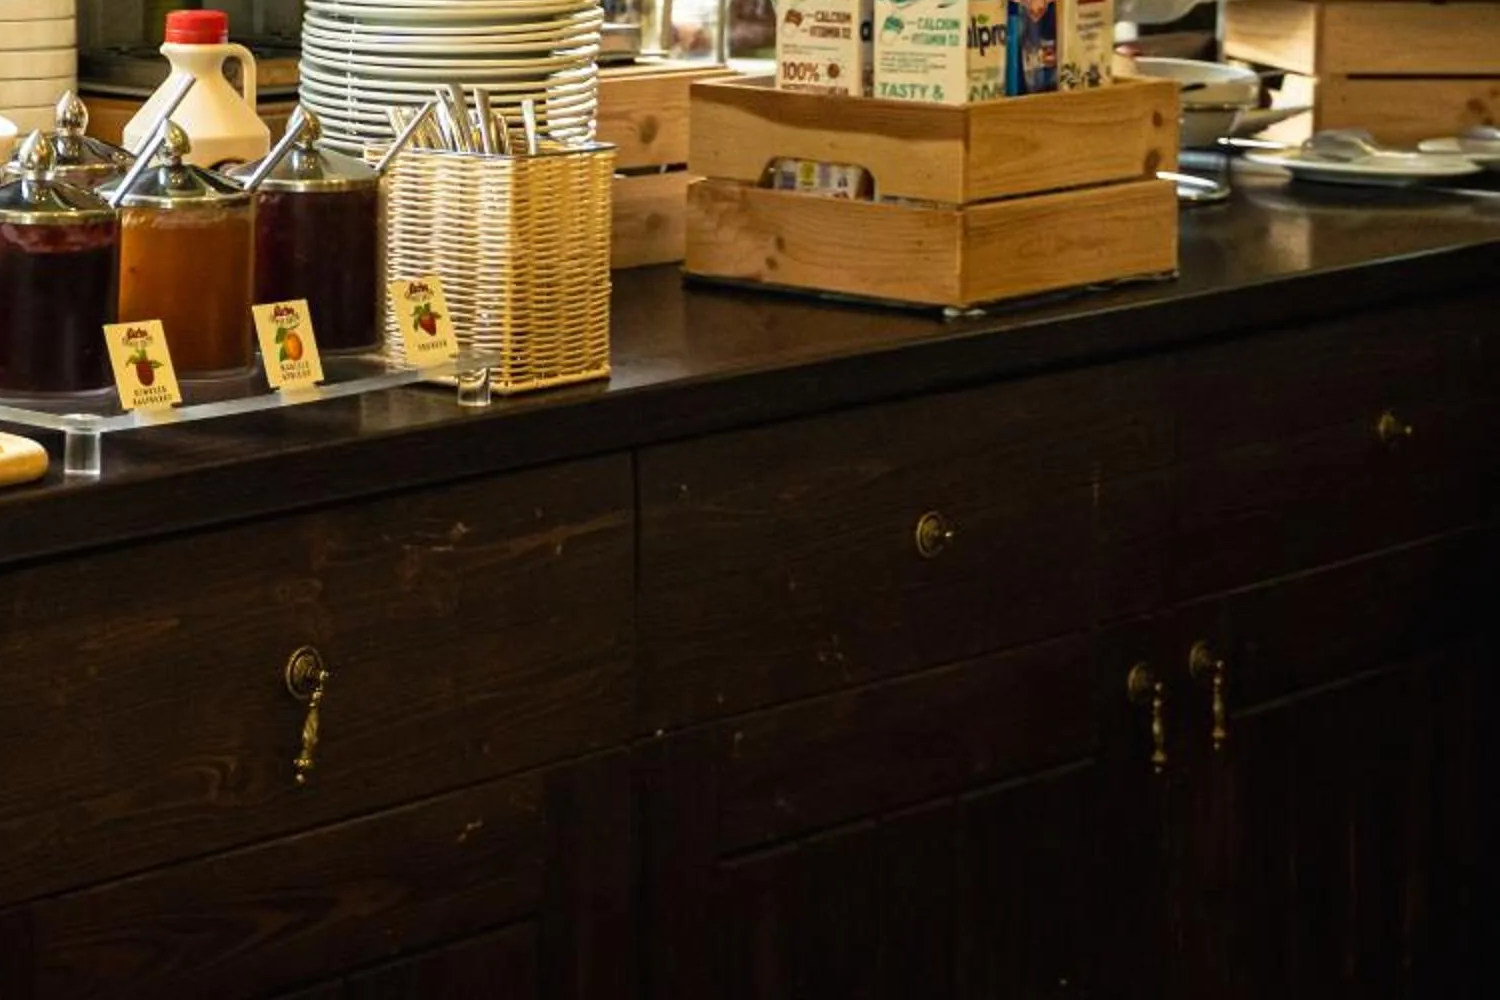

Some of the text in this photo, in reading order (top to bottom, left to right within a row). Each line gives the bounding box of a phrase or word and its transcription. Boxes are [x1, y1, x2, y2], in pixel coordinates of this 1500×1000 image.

[814, 10, 852, 23] CALCIUM
[917, 17, 961, 31] CALCIUM
[782, 61, 820, 82] 100%
[880, 82, 944, 99] TASTY &
